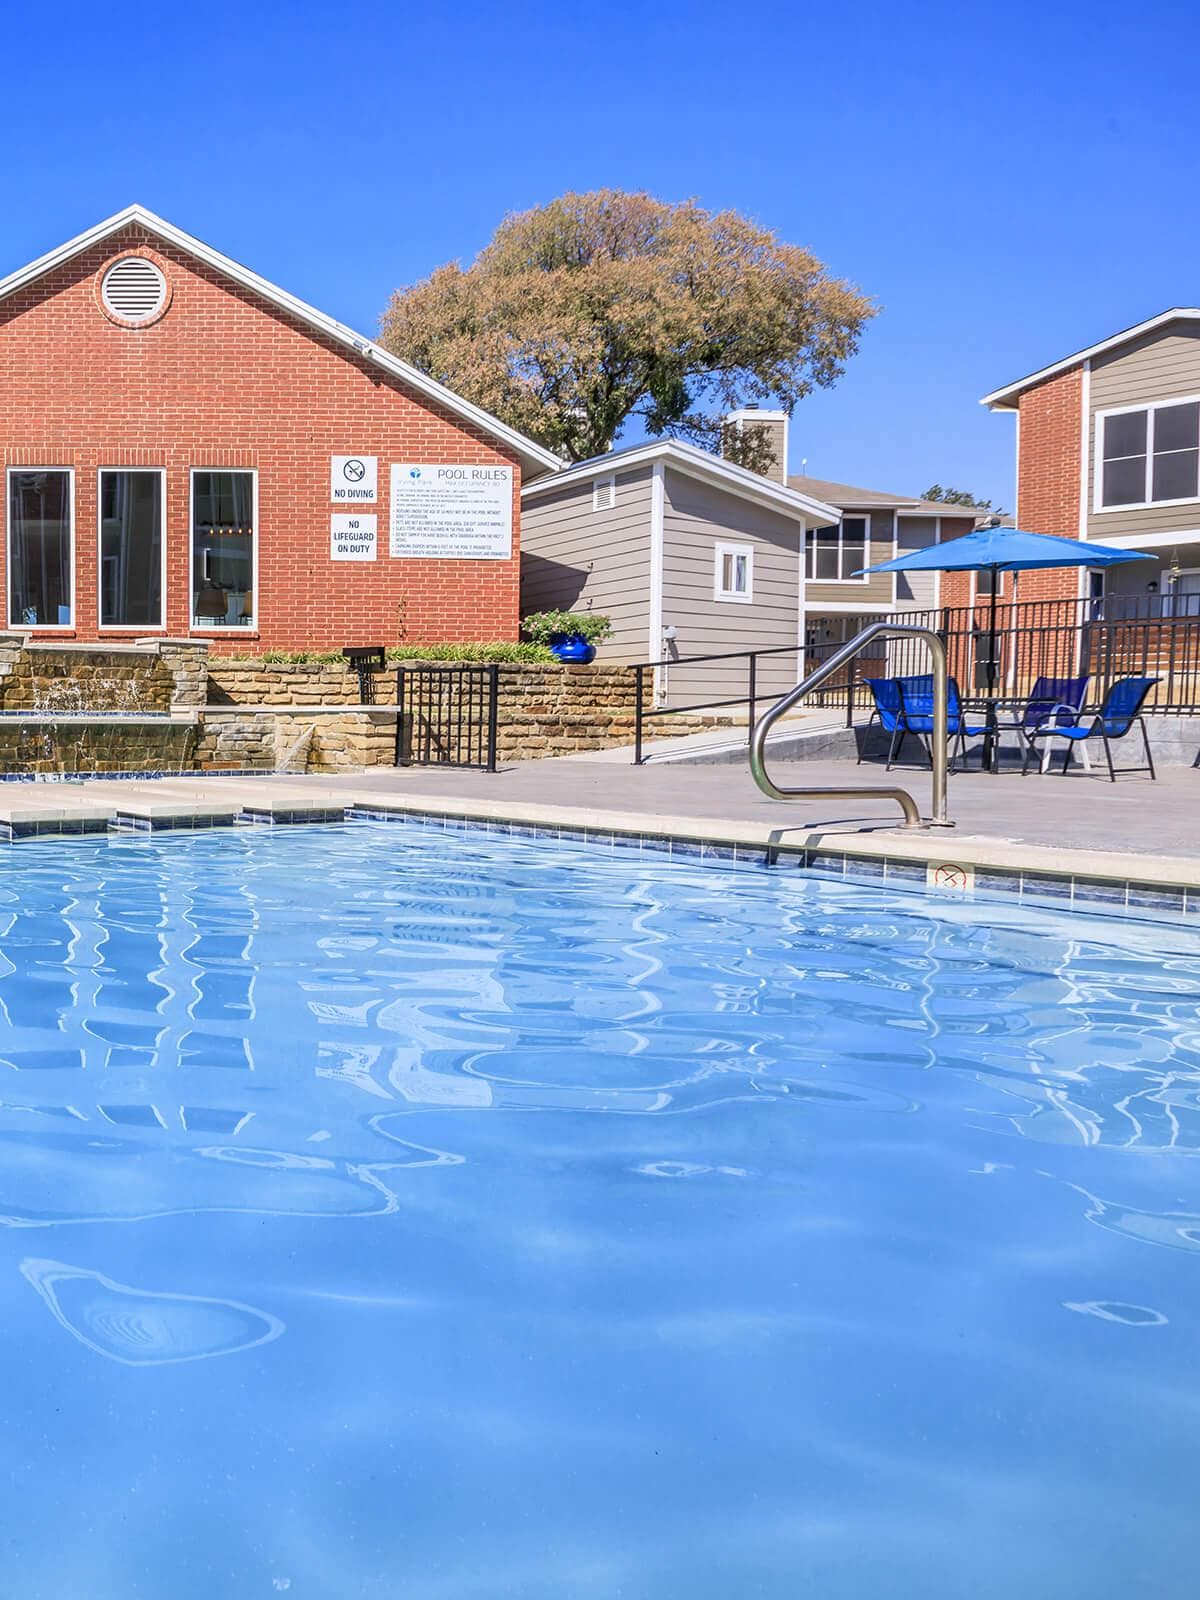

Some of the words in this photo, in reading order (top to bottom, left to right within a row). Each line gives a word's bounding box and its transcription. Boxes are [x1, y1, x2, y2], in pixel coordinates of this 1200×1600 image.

[437, 469, 469, 480] POOL
[472, 470, 508, 481] RULES
[334, 489, 346, 498] NO
[347, 489, 374, 498] DIVING
[348, 520, 360, 528] NO
[333, 532, 374, 541] LIFEGUARD
[337, 544, 348, 553] ON
[350, 544, 370, 553] DUTY
